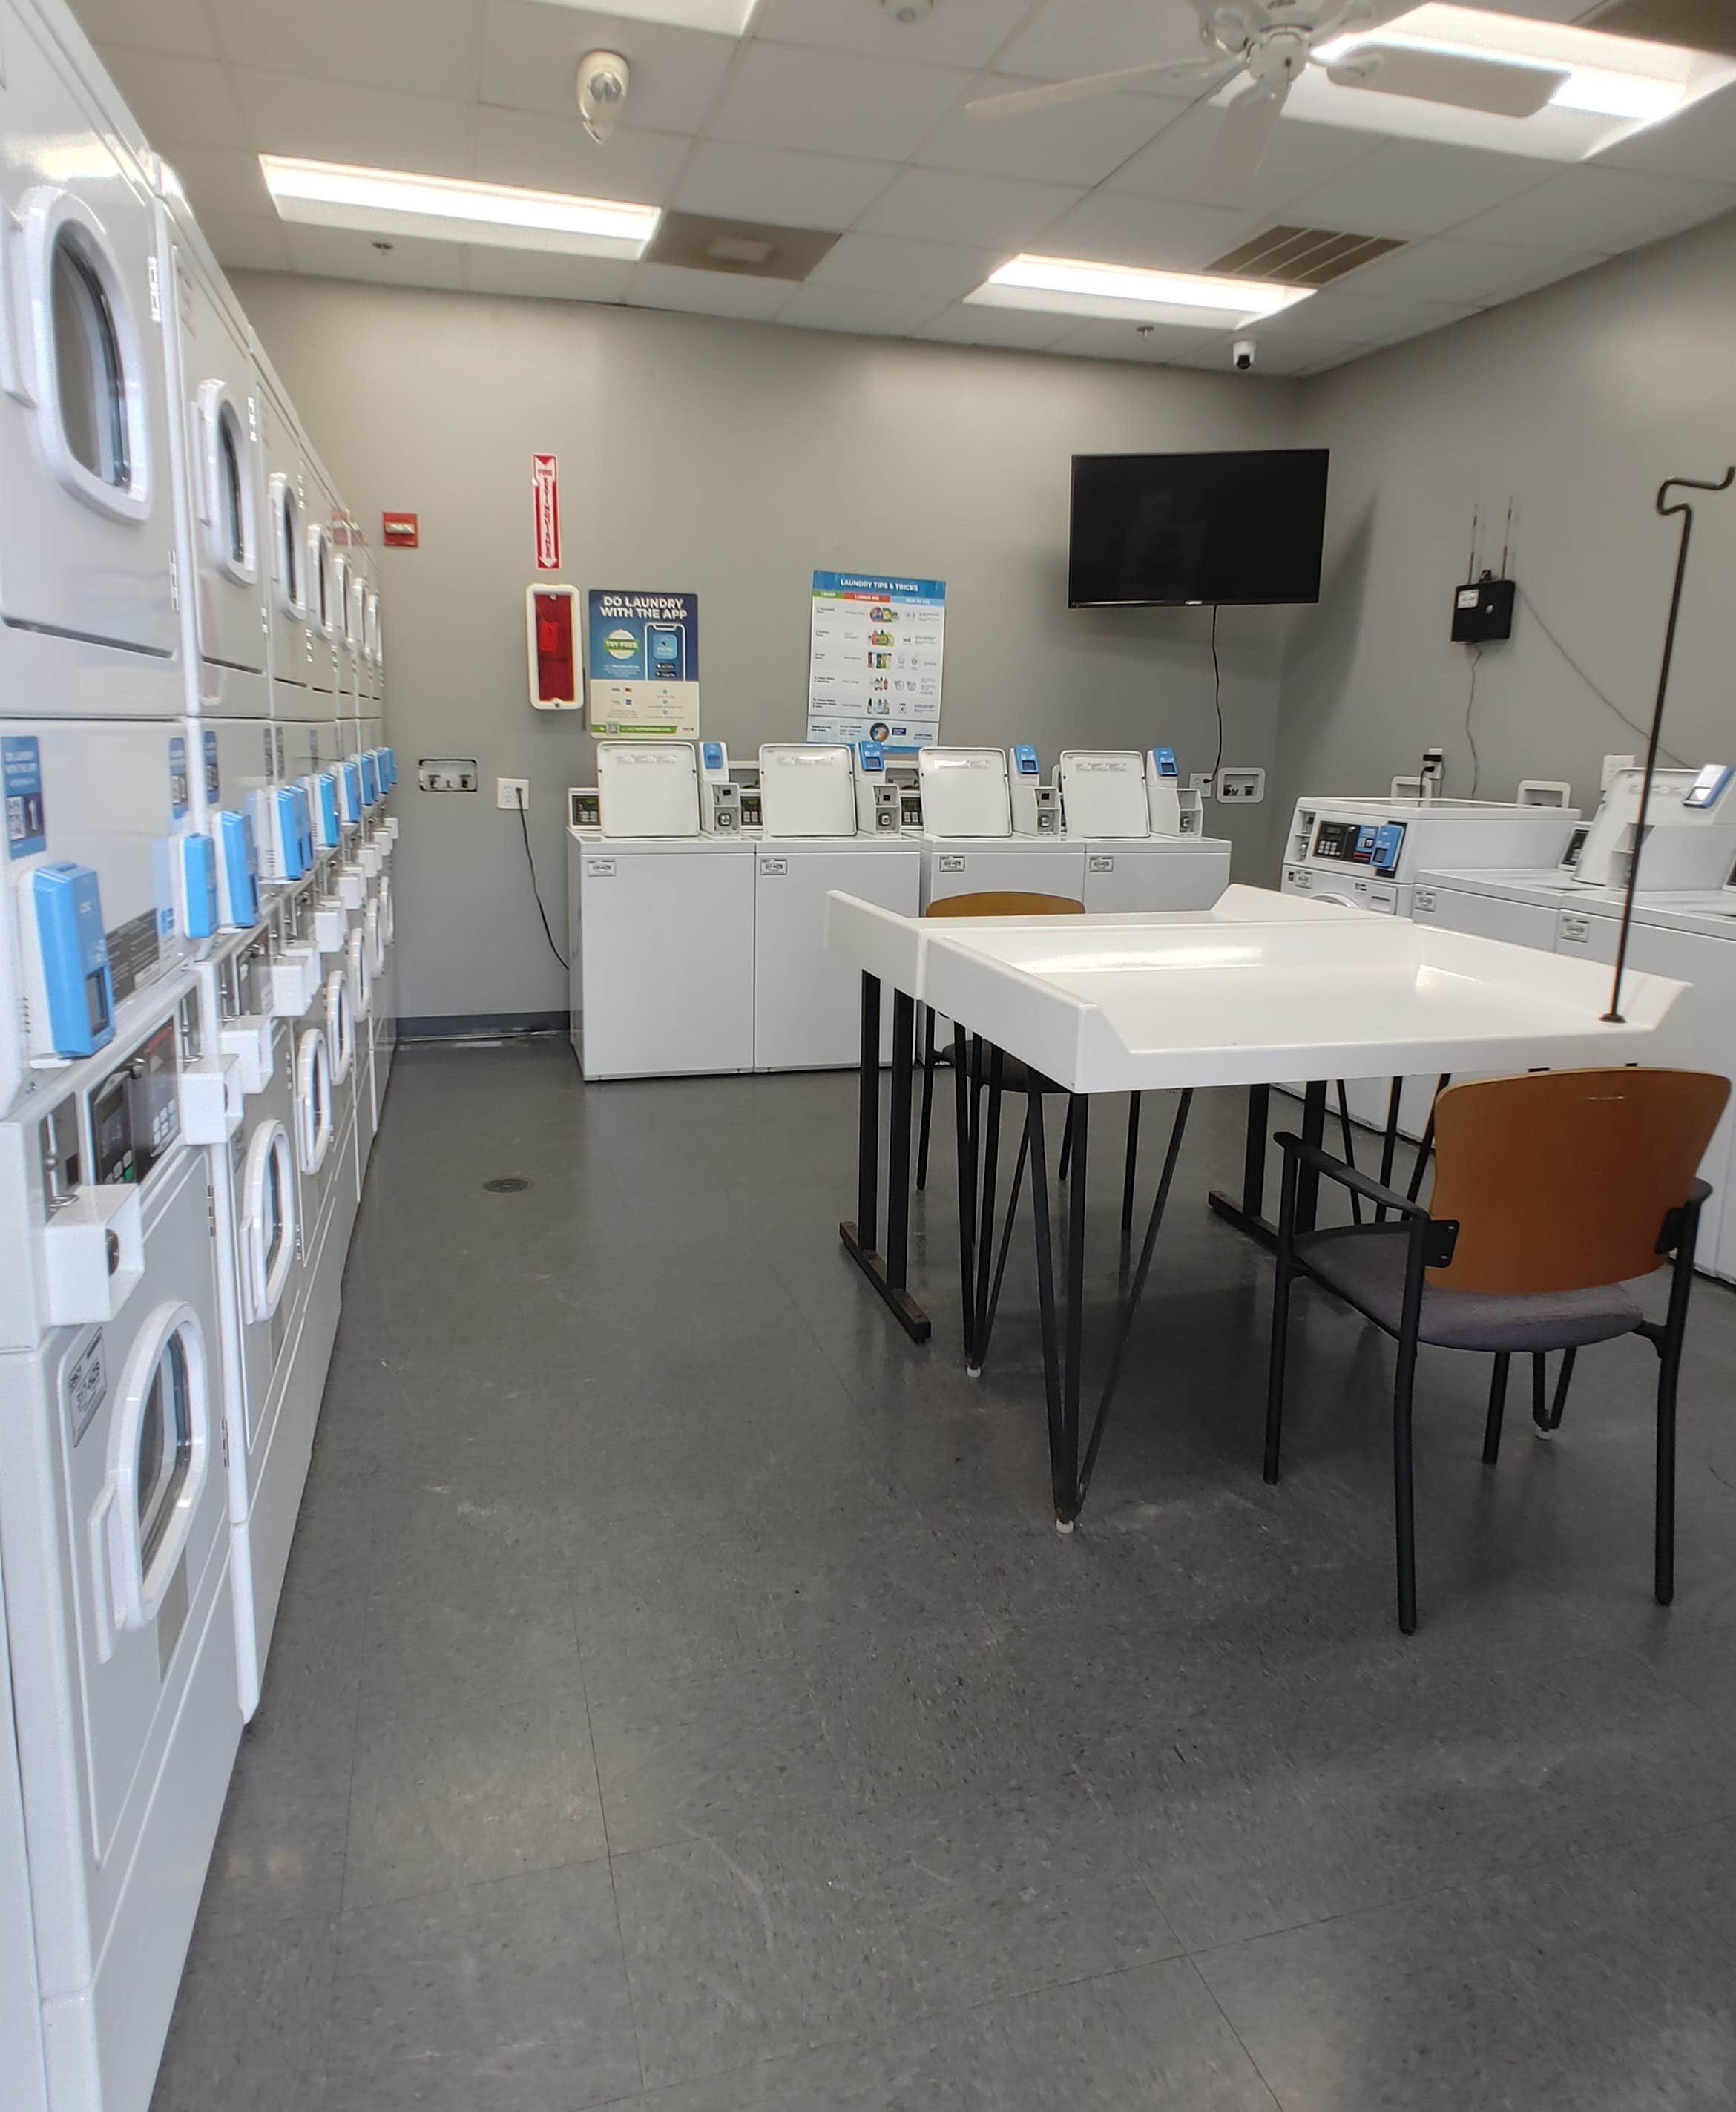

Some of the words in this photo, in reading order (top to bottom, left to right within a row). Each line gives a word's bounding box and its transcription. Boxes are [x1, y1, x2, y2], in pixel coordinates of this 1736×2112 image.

[840, 579, 872, 588] LAUNDRY
[874, 581, 889, 590] TIPS
[895, 583, 919, 592] TRICKS
[602, 596, 622, 606] DO
[625, 596, 683, 609] LAUNDRY
[599, 606, 634, 617] WITH
[636, 608, 661, 619] THE
[662, 609, 688, 620] APP
[619, 641, 639, 649] FREE
